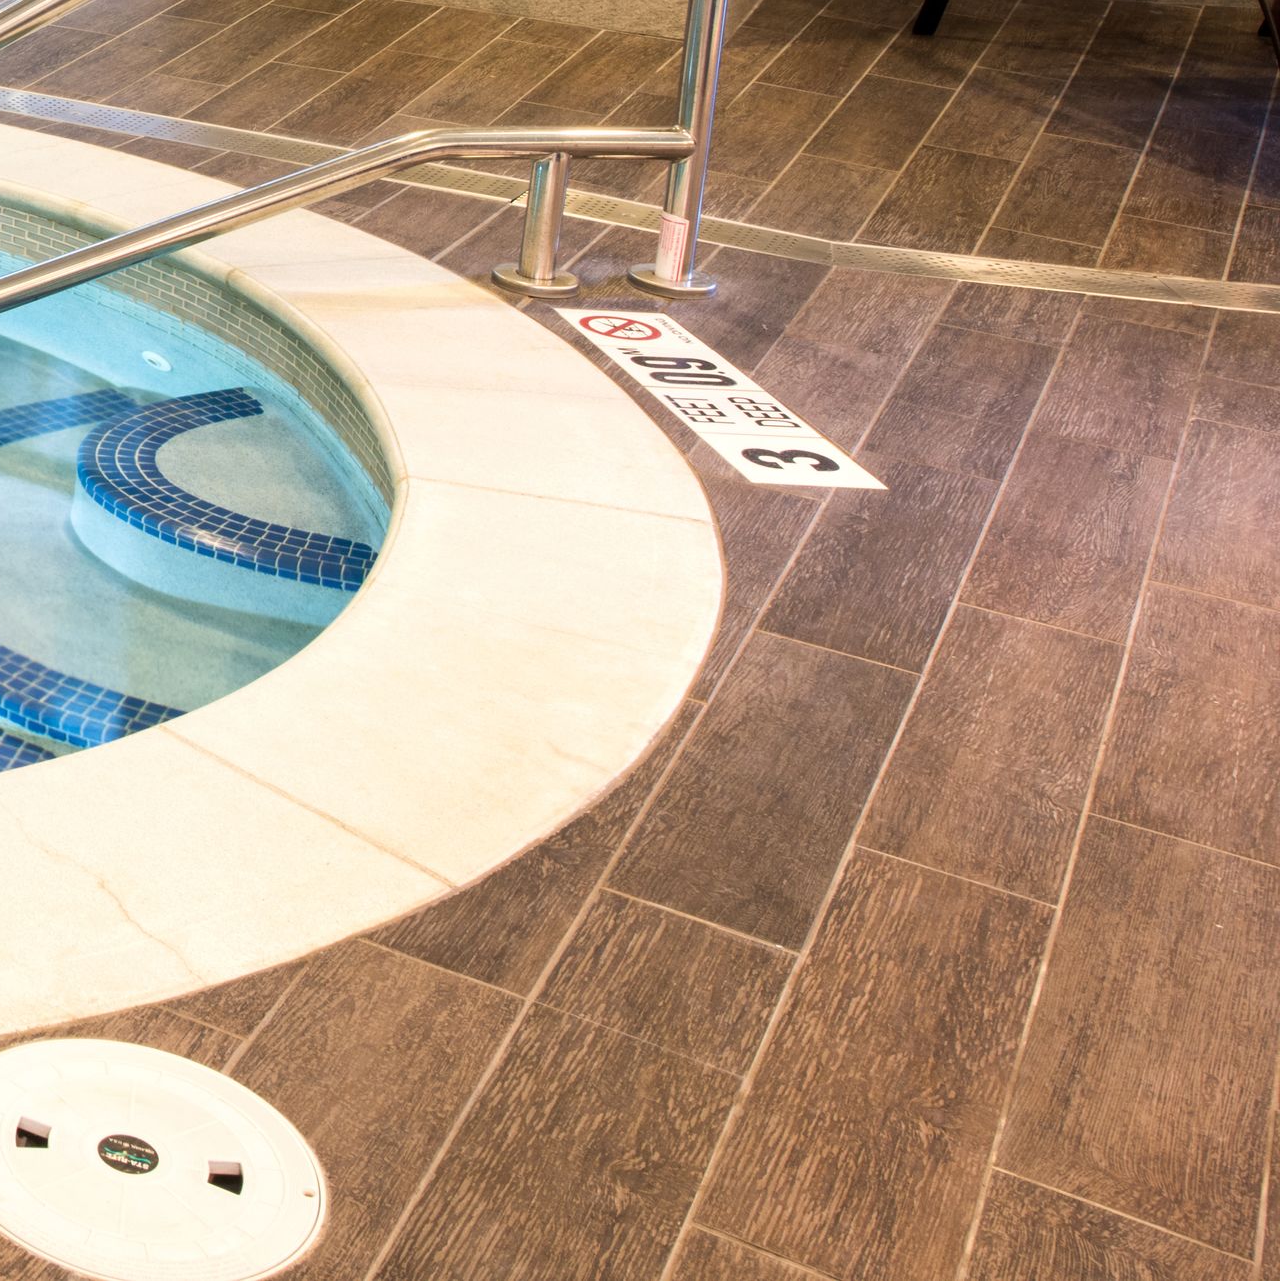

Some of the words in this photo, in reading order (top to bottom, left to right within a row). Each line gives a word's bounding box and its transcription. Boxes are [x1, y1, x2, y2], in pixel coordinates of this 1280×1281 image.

[665, 394, 736, 425] FEET
[727, 396, 803, 429] DEEP
[741, 447, 841, 472] 3
[105, 1151, 150, 1170] STA-RITE
